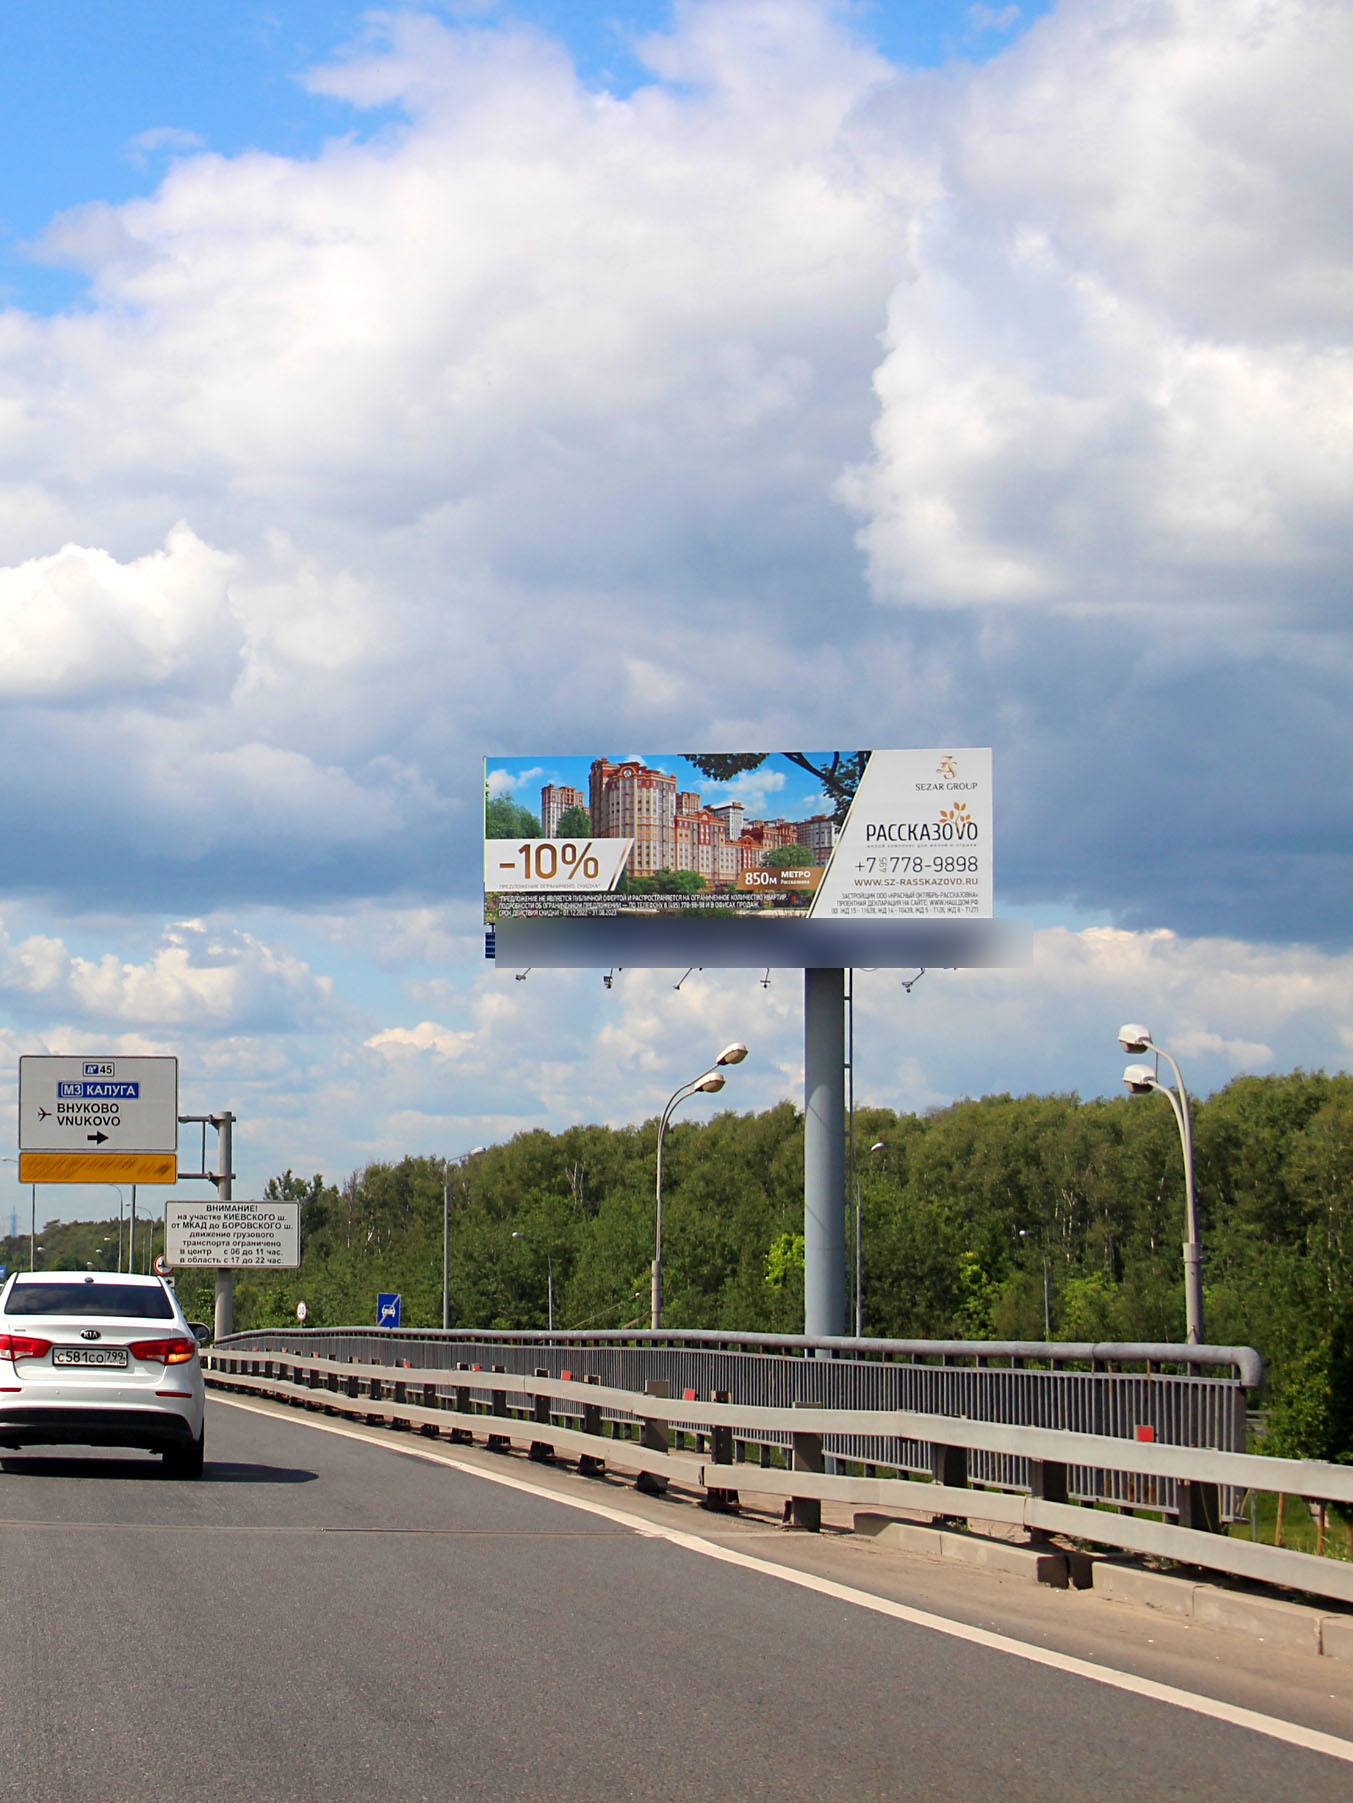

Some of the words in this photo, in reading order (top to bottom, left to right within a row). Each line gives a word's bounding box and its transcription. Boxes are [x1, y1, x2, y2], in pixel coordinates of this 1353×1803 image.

[915, 783, 944, 791] SEZAR
[946, 782, 978, 791] GROUP
[499, 842, 599, 880] -10%
[855, 857, 876, 873] +7
[890, 856, 978, 873] 778-9898
[100, 1064, 112, 1074] 45
[63, 1085, 81, 1095] М3
[86, 1085, 135, 1096] КАЛУГА
[57, 1103, 120, 1113] ВНУКОВО
[57, 1116, 121, 1126] VNUKOVO
[182, 1222, 207, 1230] МКАД
